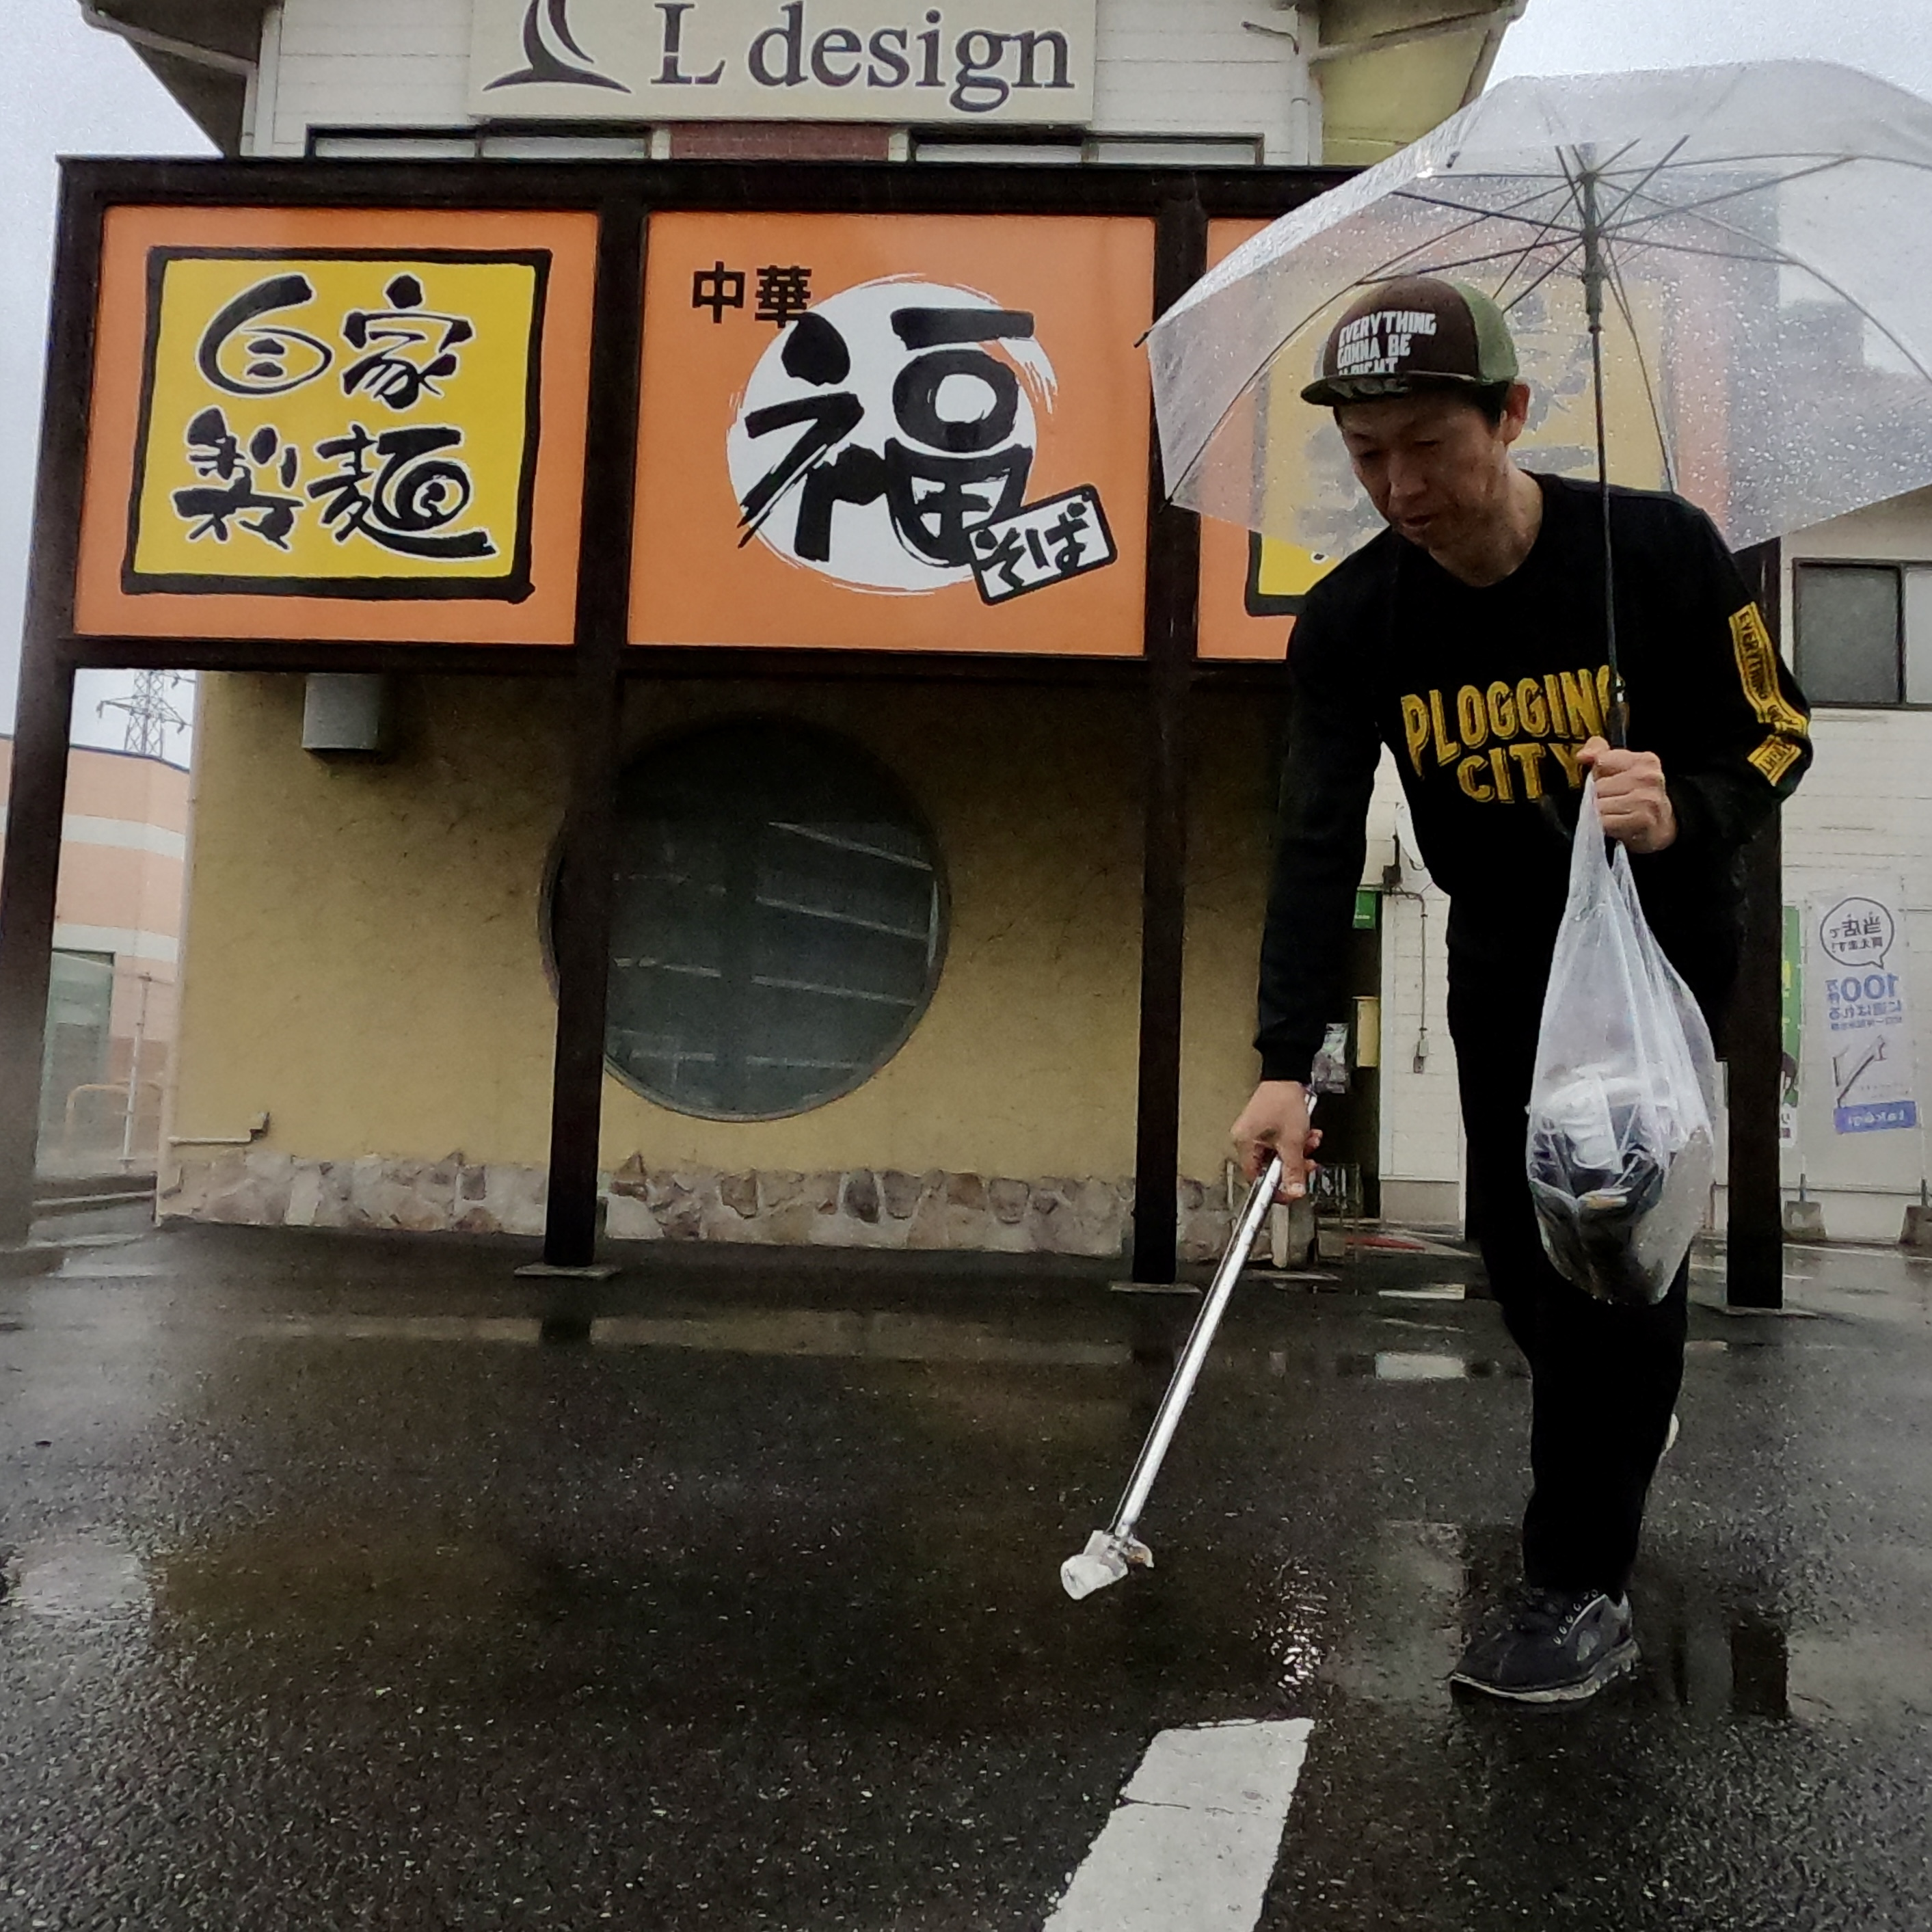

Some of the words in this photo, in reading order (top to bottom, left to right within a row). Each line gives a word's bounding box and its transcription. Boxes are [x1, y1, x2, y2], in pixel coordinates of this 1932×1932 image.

[650, 2, 725, 85] L
[747, 1, 1075, 112] design
[198, 274, 473, 410] 自家
[692, 260, 812, 329] 中華
[1339, 310, 1437, 347] EVERYTHING
[1337, 337, 1381, 370] GONNA
[1388, 334, 1412, 357] BE
[173, 406, 498, 558] 製麺
[737, 306, 1034, 568] 福
[972, 495, 1090, 592] そば
